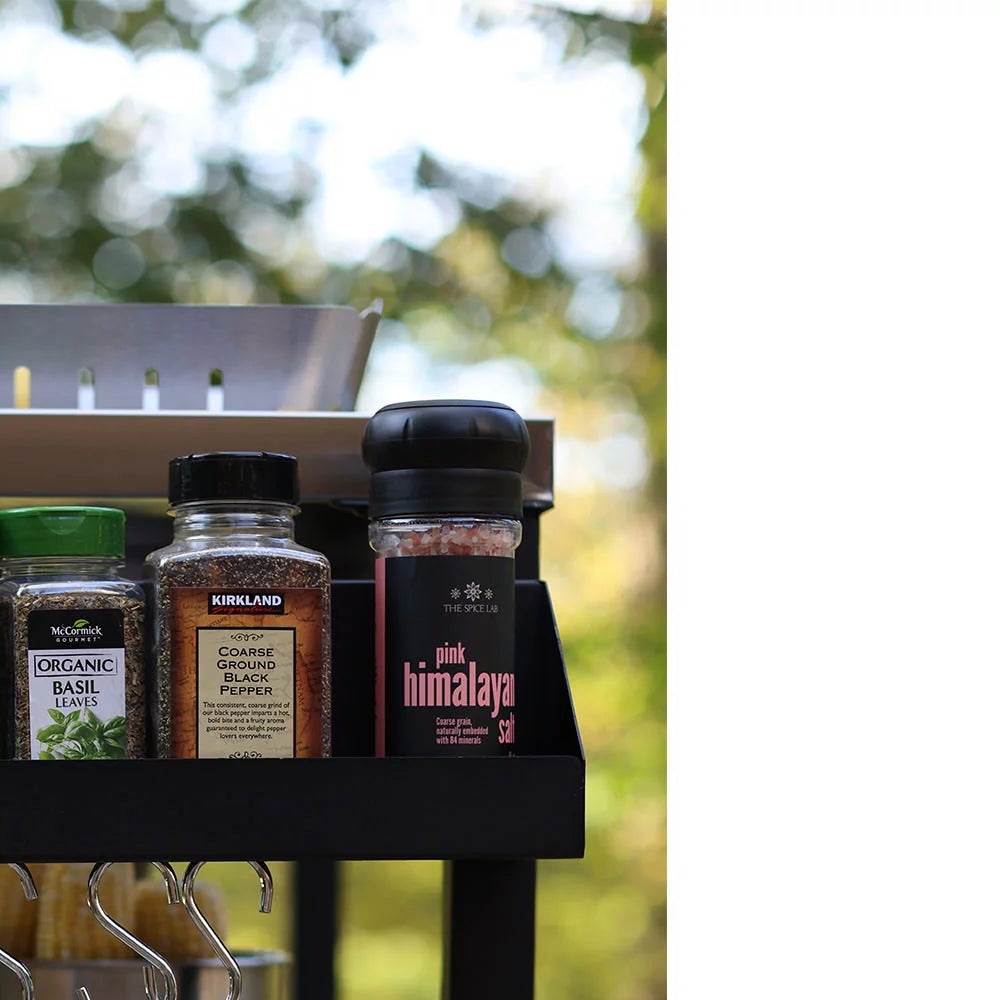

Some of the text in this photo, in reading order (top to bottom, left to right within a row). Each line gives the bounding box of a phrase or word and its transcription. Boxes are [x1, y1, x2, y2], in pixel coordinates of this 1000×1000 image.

[212, 595, 282, 606] KIRKLAND
[443, 604, 499, 613] THE SPICE LAB
[50, 625, 103, 636] McCormick
[218, 646, 274, 657] COARSE
[436, 642, 466, 669] pink
[37, 658, 114, 672] ORGANIC
[217, 659, 276, 670] GROUND
[224, 672, 269, 683] BLACK
[52, 680, 100, 695] BASIL
[220, 685, 273, 696] PEPPER
[55, 696, 98, 708] LEAVES
[278, 709, 290, 717] hot,
[250, 717, 265, 725] fruity
[436, 717, 473, 728] Coarse grain,
[436, 726, 489, 737] naturally embedded
[436, 736, 482, 744] with 84 minerals
